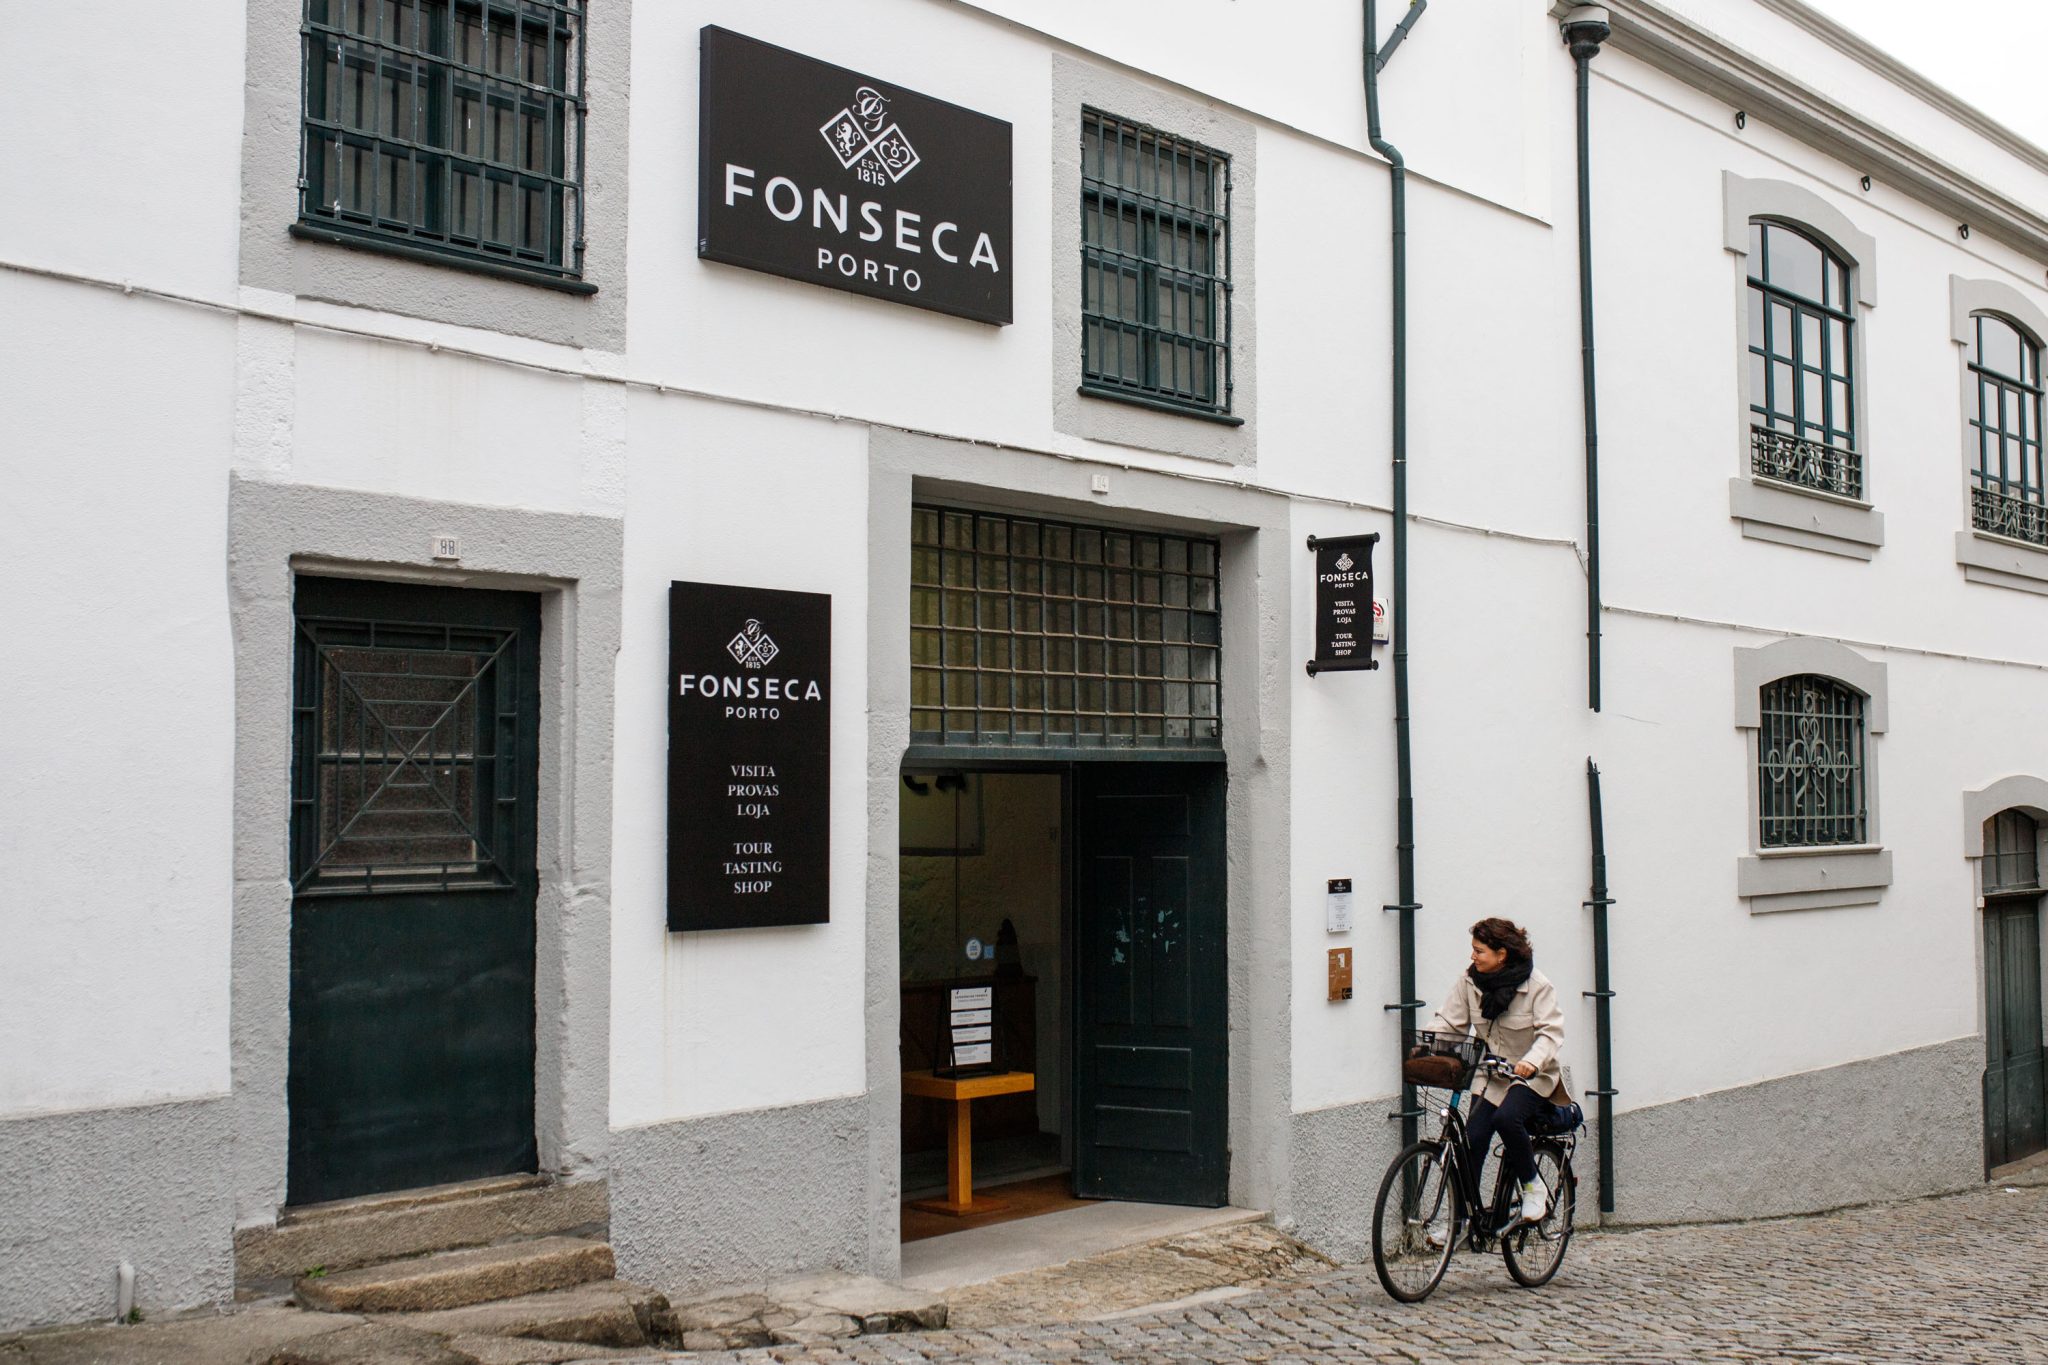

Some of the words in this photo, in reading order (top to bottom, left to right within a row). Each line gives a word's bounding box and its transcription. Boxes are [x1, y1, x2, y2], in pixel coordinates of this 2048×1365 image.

[861, 159, 881, 170] EST
[856, 168, 886, 187] 1815
[725, 163, 1000, 273] FONSECA
[817, 247, 922, 292] PORTO
[440, 540, 455, 555] 88
[1320, 571, 1369, 583] FONSECA
[745, 661, 761, 669] 1815
[679, 674, 822, 702] FONSECA
[725, 706, 780, 720] PORTO
[730, 765, 776, 778] VISITA
[727, 784, 780, 797] PROVAS
[736, 803, 771, 819] LOJA
[733, 842, 773, 856] TOUR
[723, 861, 783, 875] TASTING
[733, 880, 773, 894] SHOP
